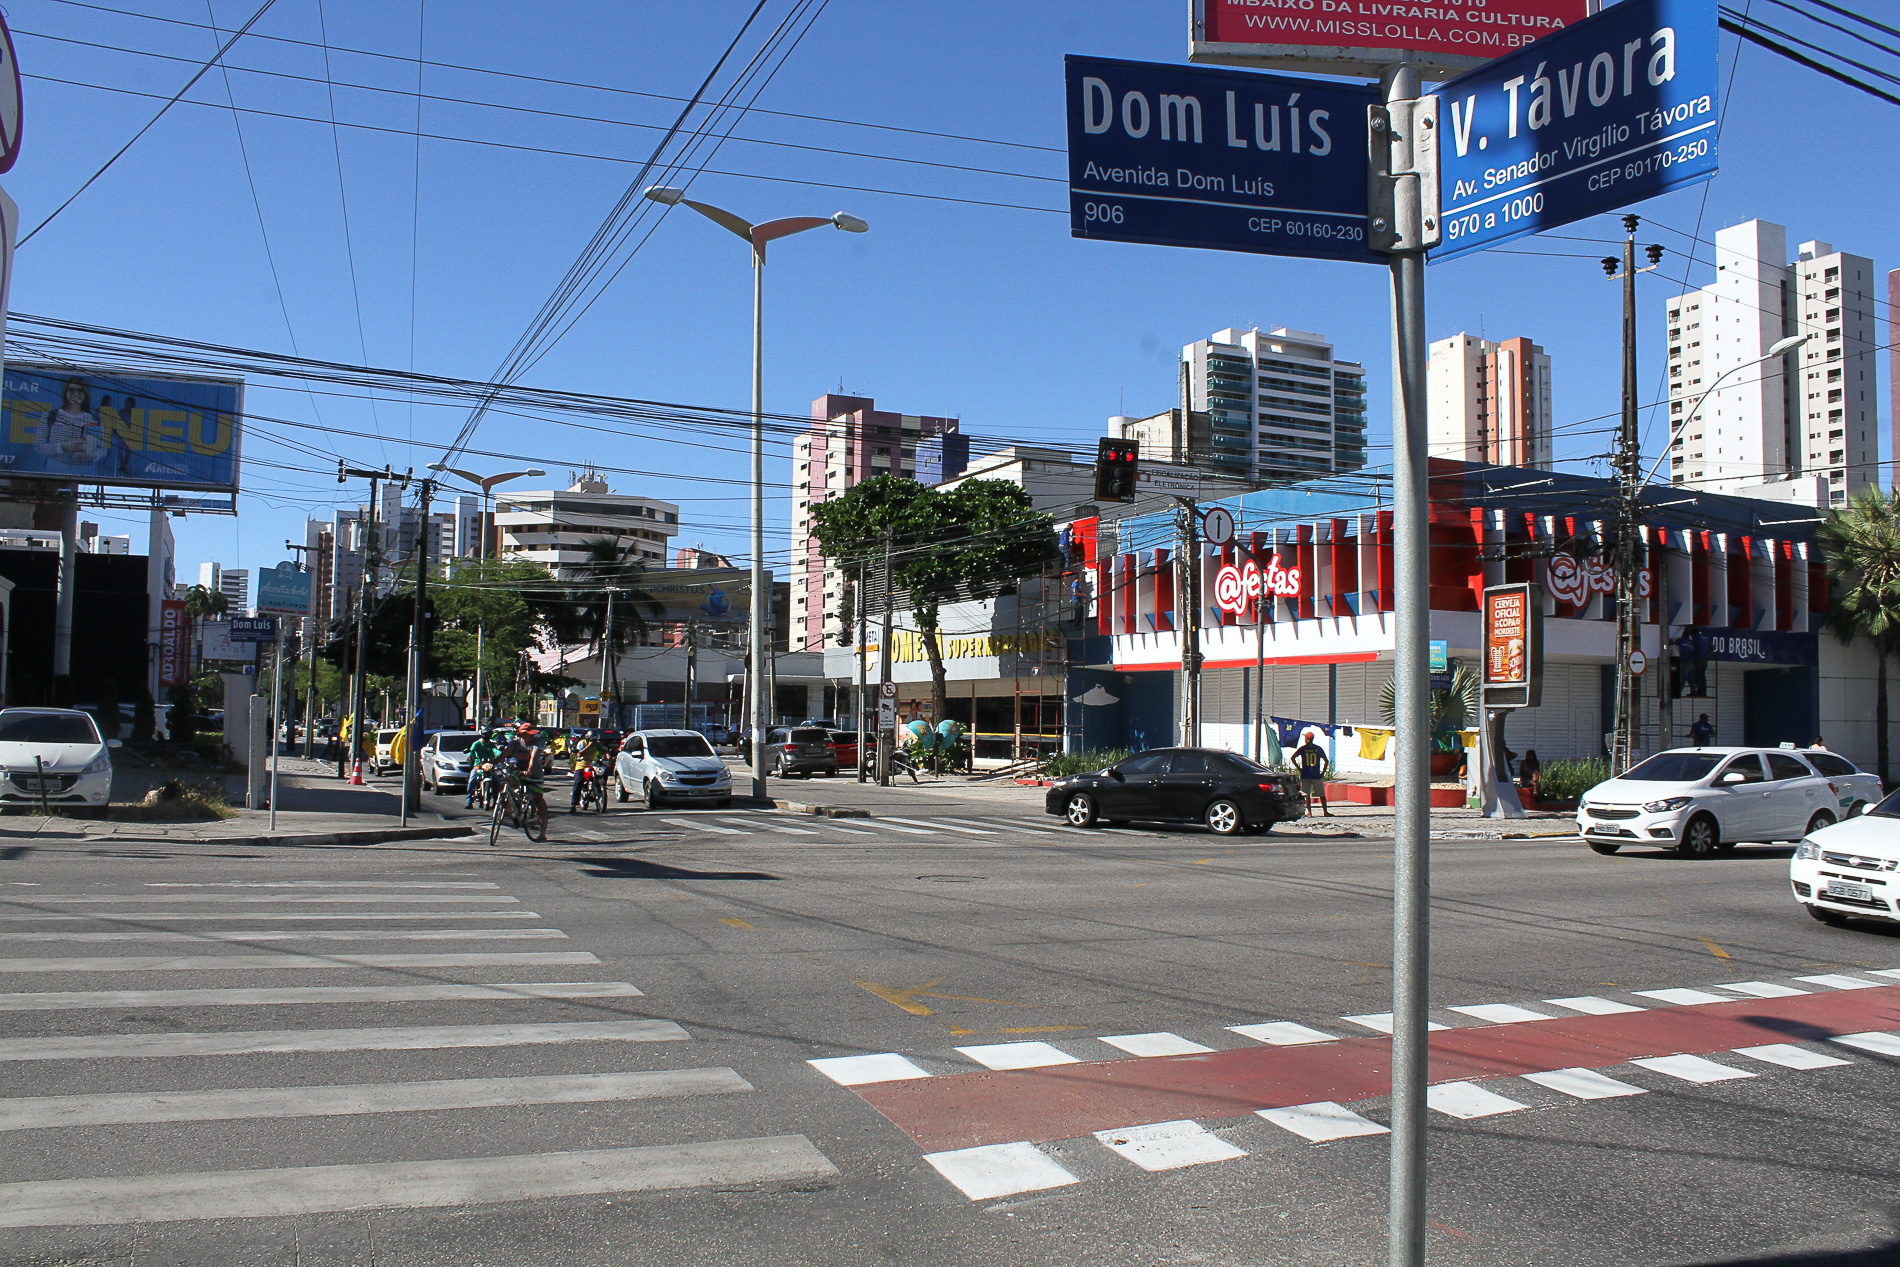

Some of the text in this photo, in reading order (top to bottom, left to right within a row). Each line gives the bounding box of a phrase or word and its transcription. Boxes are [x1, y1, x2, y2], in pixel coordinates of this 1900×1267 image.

[1321, 2, 1353, 14] DA
[1359, 4, 1460, 21] LIVRARIA
[1466, 11, 1565, 29] CULTURA
[1245, 14, 1536, 48] WWW.MISSLOLLA.COM.BR
[1451, 26, 1676, 158] V. Távora
[1083, 76, 1332, 156] Dom Luís
[1452, 95, 1711, 201] Av. Senador Virgílio Távora
[1588, 138, 1708, 191] CEP 60170-250
[1083, 161, 1275, 196] Avenida Dom Luís
[1084, 202, 1124, 224] 906
[1448, 192, 1544, 240] 970 a 1000
[1248, 217, 1363, 241] CEP 60160-230
[1154, 480, 1196, 491] ELETRÔNICA
[1494, 599, 1521, 609] CERVEJA
[1494, 608, 1521, 619] OFICIAL
[233, 619, 251, 629] Dom
[1494, 627, 1521, 636] NORDESTE
[1499, 619, 1516, 628] COPA
[161, 609, 177, 682] ADROALDO
[858, 630, 879, 644] CETA
[891, 627, 944, 663] OMEA
[1305, 752, 1317, 767] 10
